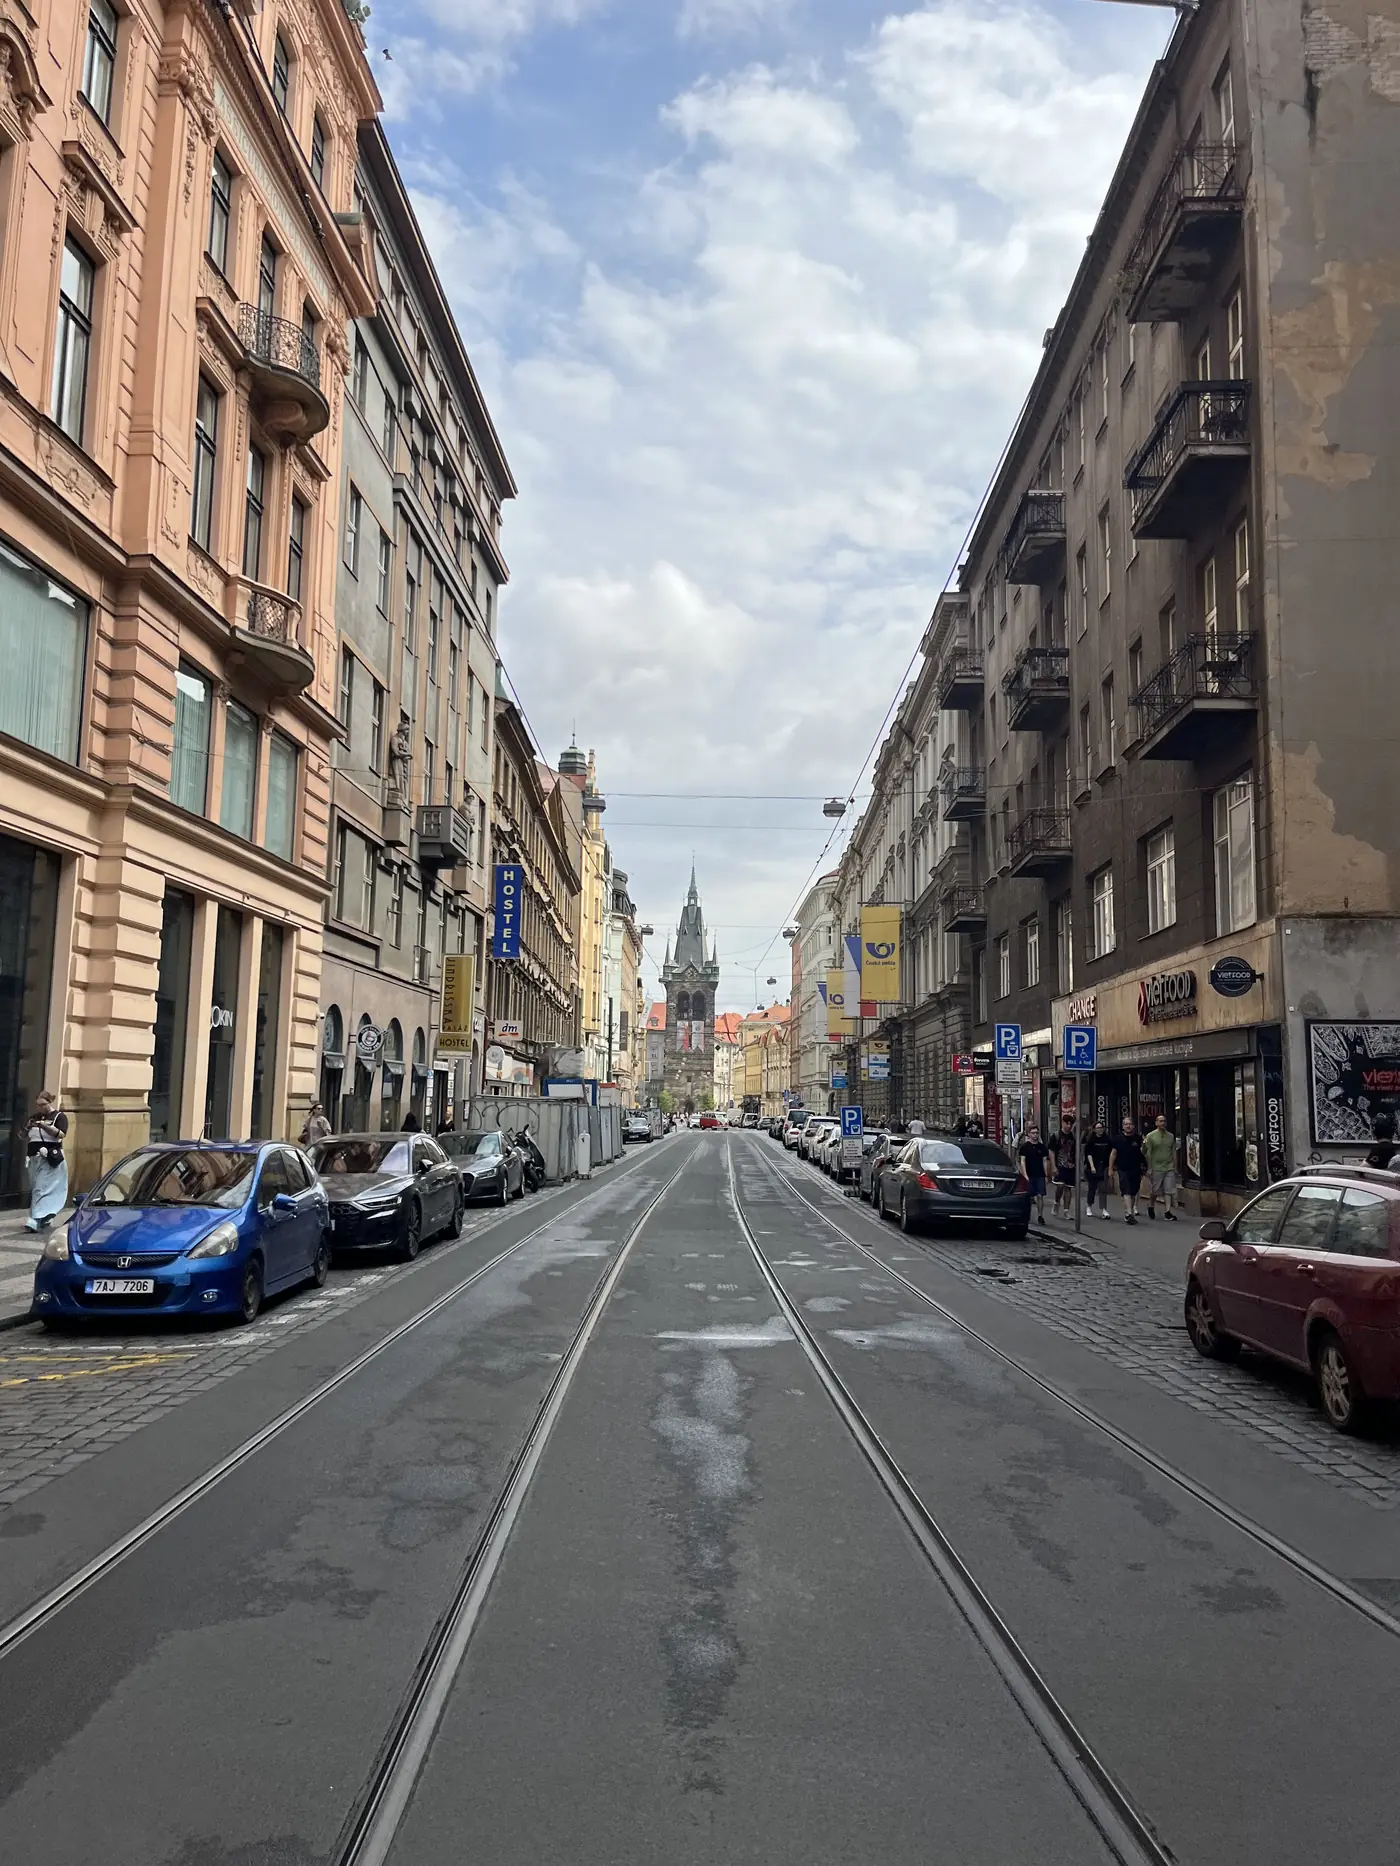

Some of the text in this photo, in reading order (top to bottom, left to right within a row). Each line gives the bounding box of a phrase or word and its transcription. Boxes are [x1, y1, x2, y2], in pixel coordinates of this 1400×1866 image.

[502, 870, 515, 953] HOSTEL
[1068, 995, 1096, 1022] CHANGE
[501, 1023, 518, 1033] dm
[1001, 1027, 1016, 1049] P
[439, 1038, 469, 1047] HOSTEL
[1071, 1031, 1090, 1057] P
[845, 1109, 858, 1128] P
[95, 1281, 149, 1292] 7AJ 7206
